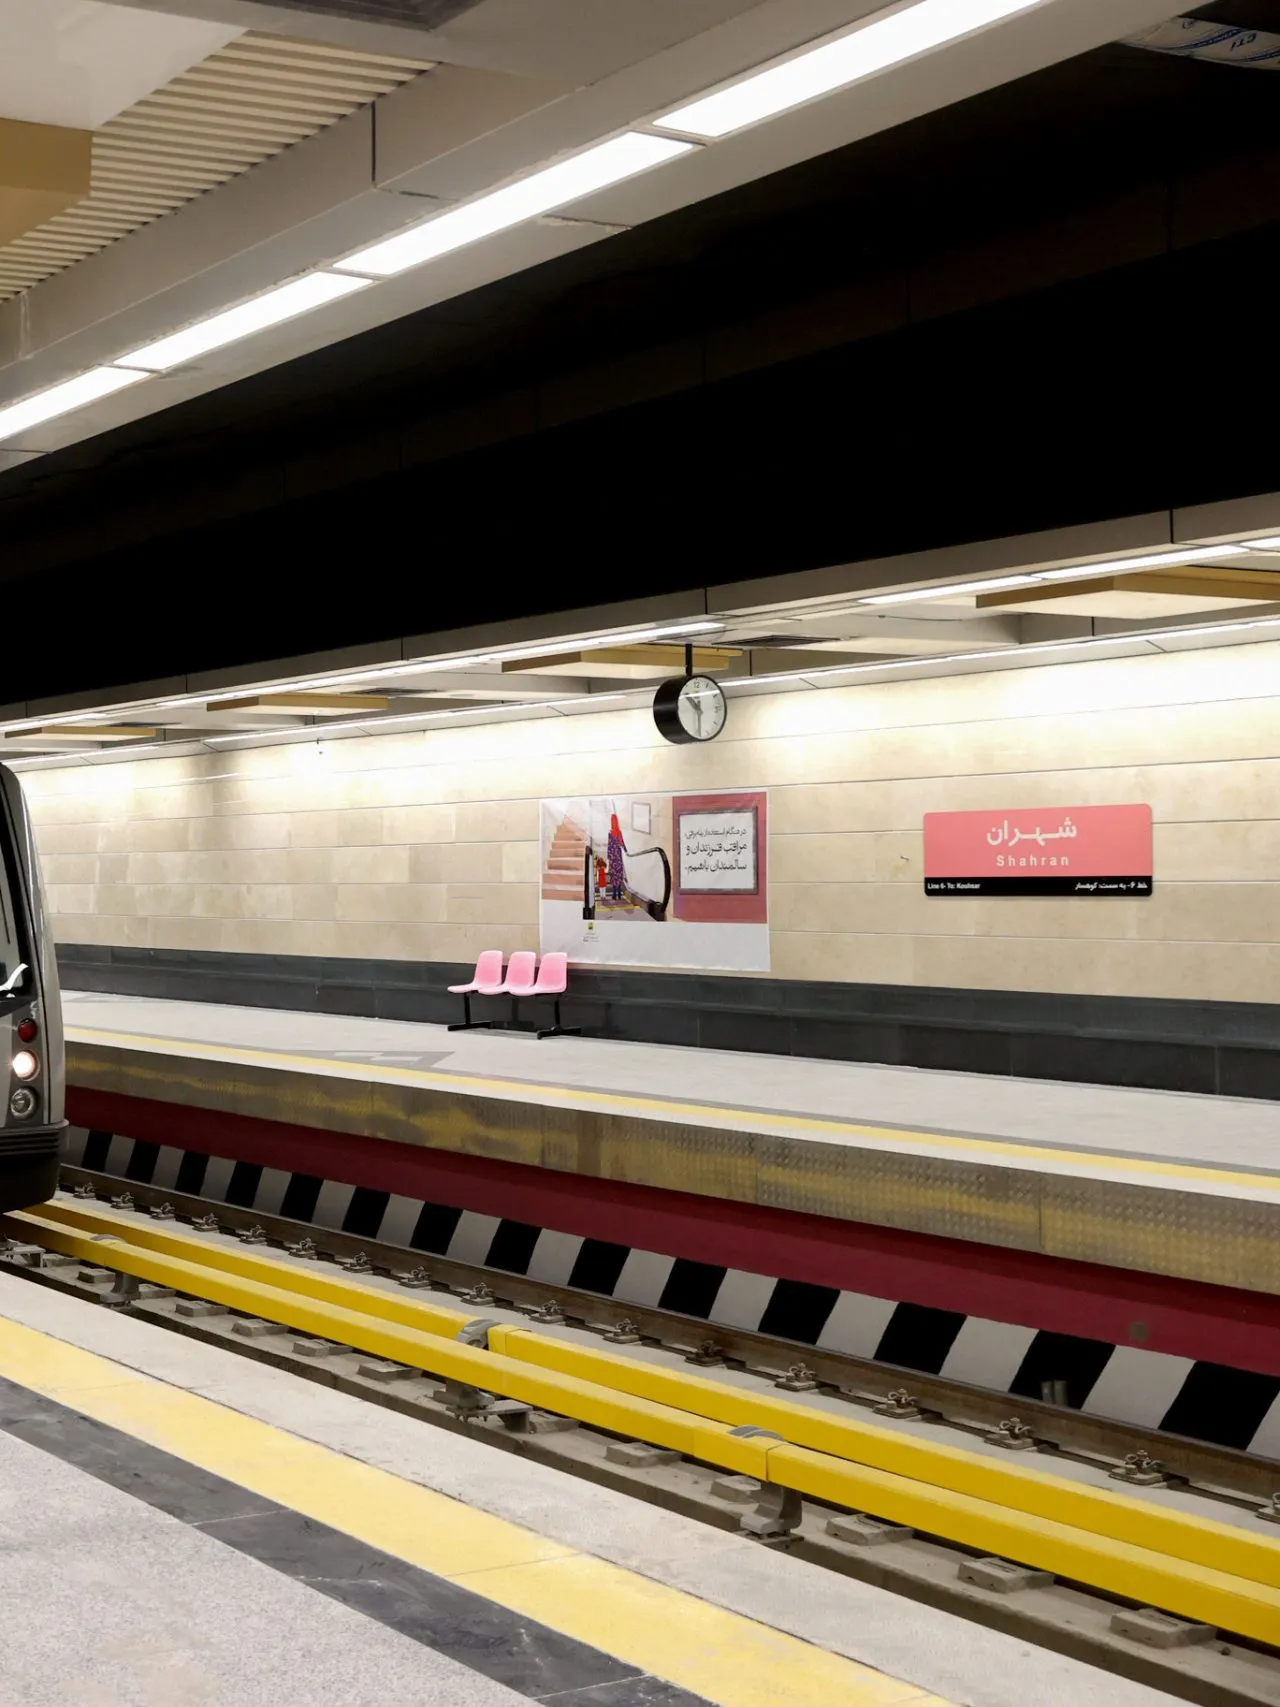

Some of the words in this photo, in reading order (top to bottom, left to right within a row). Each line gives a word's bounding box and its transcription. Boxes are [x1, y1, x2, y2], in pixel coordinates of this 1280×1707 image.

[986, 817, 1078, 846] شهران
[690, 841, 722, 857] فرزندان
[723, 840, 747, 855] مراقب
[710, 858, 747, 872] سالمندان
[996, 855, 1070, 867] Shahran
[927, 882, 939, 890] Line
